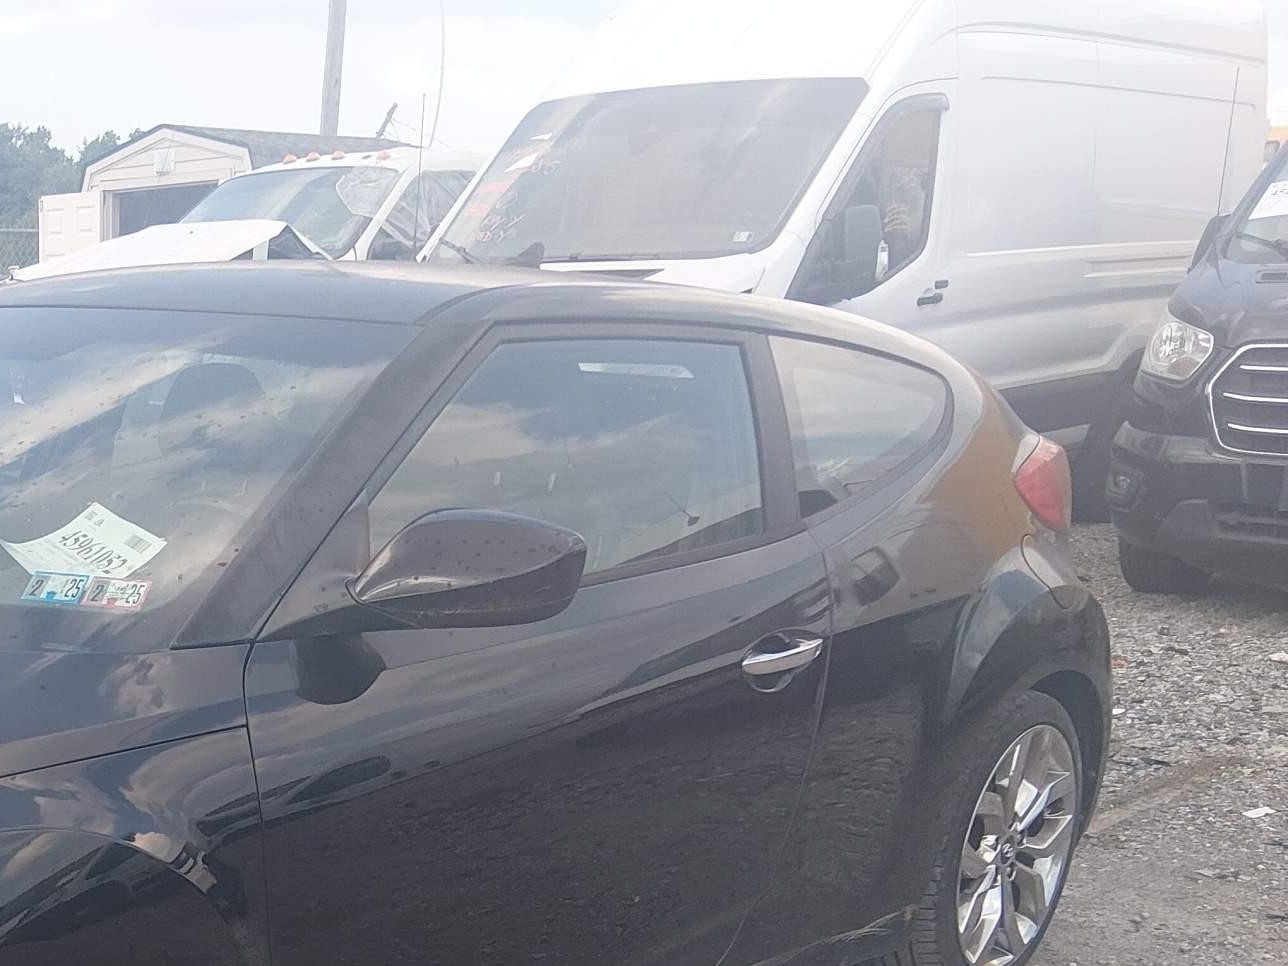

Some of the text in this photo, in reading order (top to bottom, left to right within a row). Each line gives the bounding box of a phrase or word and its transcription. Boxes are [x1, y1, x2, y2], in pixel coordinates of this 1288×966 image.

[58, 530, 128, 575] 45961052
[28, 578, 85, 599] 2 25
[89, 584, 145, 605] 2 25
